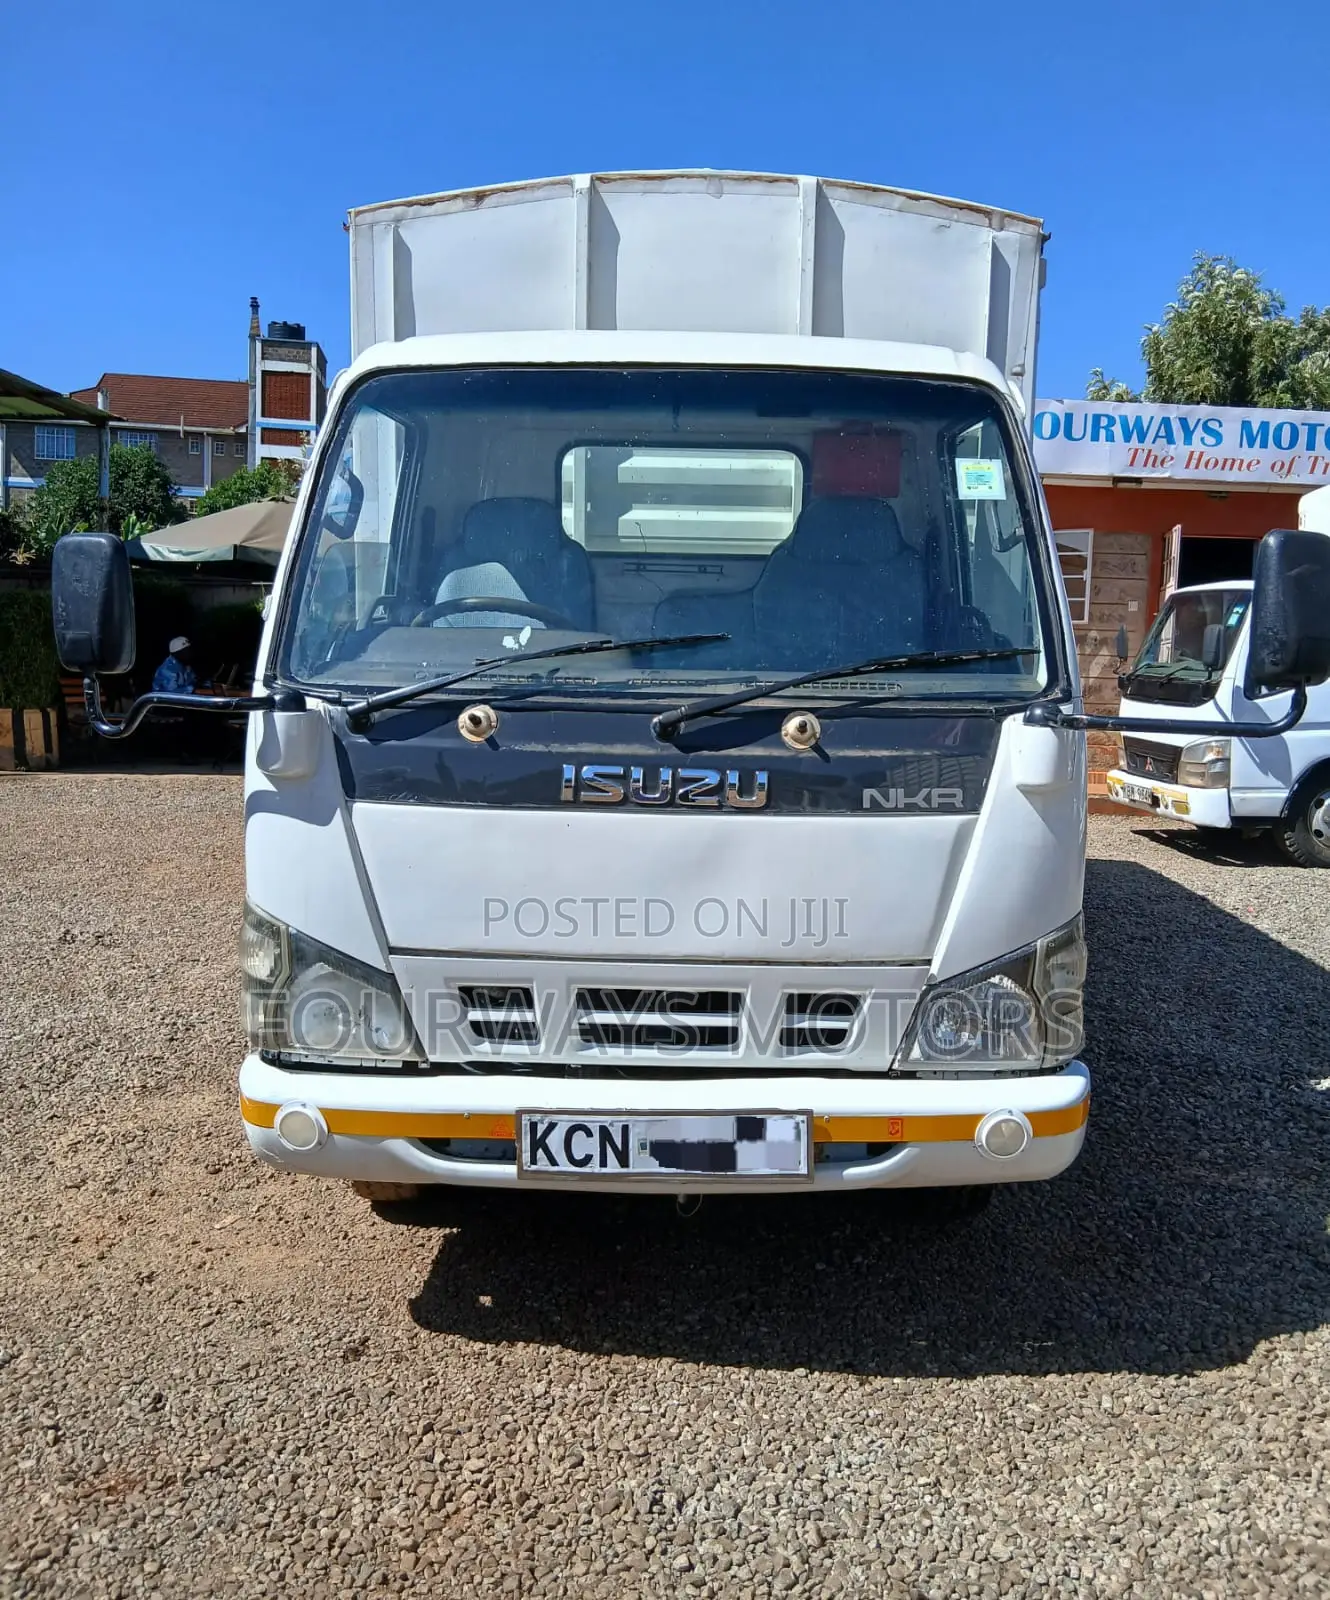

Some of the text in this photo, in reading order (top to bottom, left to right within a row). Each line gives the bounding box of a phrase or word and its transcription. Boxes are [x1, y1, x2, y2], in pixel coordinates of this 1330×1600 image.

[1033, 411, 1330, 452] OURWAYS MOT
[1127, 447, 1175, 469] The
[1184, 450, 1261, 473] Home
[1270, 455, 1302, 479] of
[560, 763, 769, 808] ISUZU
[862, 787, 965, 809] NKR
[528, 1120, 631, 1169] KCN
